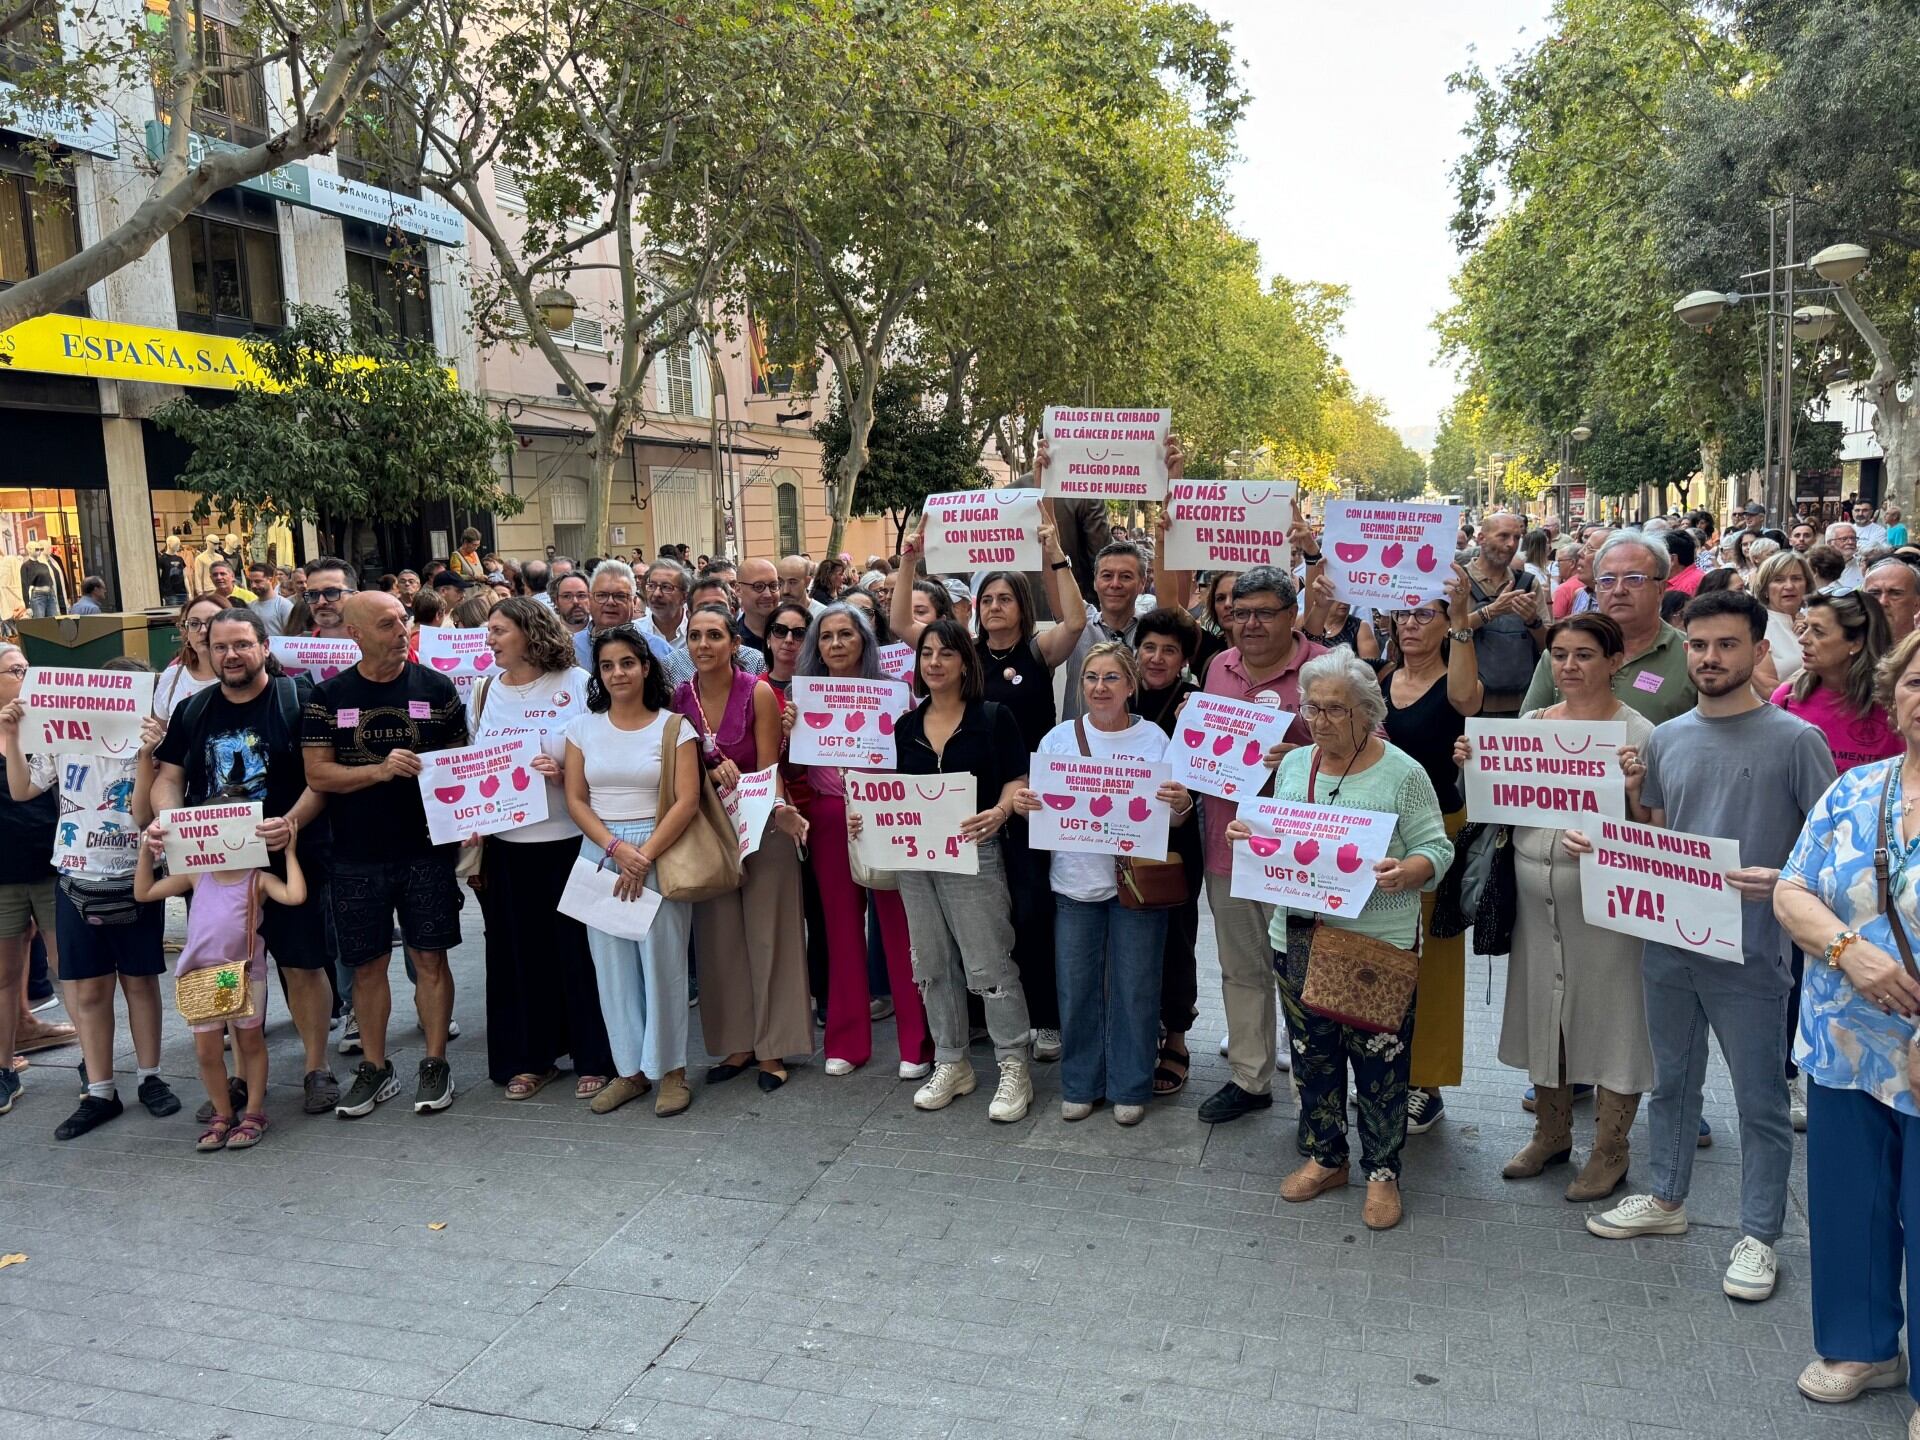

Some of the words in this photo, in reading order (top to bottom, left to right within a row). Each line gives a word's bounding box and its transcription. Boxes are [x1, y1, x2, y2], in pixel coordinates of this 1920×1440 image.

[431, 212, 440, 222] DE
[443, 217, 459, 227] VIDA
[1055, 411, 1088, 422] FALLOS
[1091, 412, 1102, 422] EN
[1104, 412, 1114, 422] EL
[1117, 412, 1160, 422] CRIBADO
[1055, 428, 1071, 438] DEL
[1073, 427, 1108, 439] CÁNCER
[1111, 429, 1123, 439] DE
[1125, 430, 1155, 440] MAMA
[1069, 464, 1110, 475] PELIGRO
[1112, 465, 1140, 476] PARA
[1061, 481, 1088, 492] MILES
[1090, 482, 1102, 493] DE
[1104, 483, 1147, 494] MUJERES
[1174, 485, 1193, 499] NO
[1196, 483, 1227, 500] MÁS
[928, 495, 966, 506] BASTA
[970, 494, 985, 503] YA
[943, 510, 957, 522] DE
[960, 508, 998, 522] JUGAR
[1176, 505, 1246, 522] RECORTES
[1346, 509, 1361, 518] CON
[1363, 510, 1372, 519] LA
[1374, 510, 1396, 520] MANO
[1398, 512, 1407, 521] EN
[1409, 512, 1416, 521] EL
[1418, 513, 1442, 523] PECHO
[945, 530, 967, 543] CON
[971, 528, 1024, 542] NUESTRA
[1196, 528, 1213, 542] EN
[1217, 529, 1283, 546] SANIDAD
[1360, 523, 1394, 533] DECIMOS
[1395, 525, 1425, 536] ¡BASTA!
[968, 548, 1015, 563] SALUD
[1210, 546, 1270, 564] PUBLICA
[1349, 571, 1376, 584] UGT
[38, 672, 51, 685] NI
[55, 672, 84, 686] UNA
[88, 674, 132, 689] MUJER
[826, 684, 834, 692] LA
[835, 684, 855, 692] MANO
[857, 685, 865, 693] EN
[866, 686, 873, 694] EL
[873, 687, 892, 696] PECHO
[31, 694, 136, 712] DESINFORMADA
[824, 696, 855, 704] DECIMOS
[856, 696, 881, 705] ¡BASTA!
[525, 710, 546, 718] UGT
[1197, 700, 1209, 710] CON
[1209, 702, 1217, 711] LA
[1218, 703, 1235, 715] MANO
[1235, 707, 1244, 717] EN
[1244, 709, 1252, 718] EL
[1252, 711, 1275, 723] PECHO
[1203, 713, 1230, 726] DECIMOS
[1230, 718, 1256, 732] ¡BASTA!
[43, 720, 92, 743] ¡YA!
[362, 728, 412, 739] GUESS
[819, 736, 843, 746] UGT
[1479, 736, 1498, 750] LA
[1502, 737, 1543, 752] VIDA
[436, 757, 451, 766] CON
[452, 756, 460, 764] LA
[462, 751, 484, 762] MANO
[485, 749, 494, 757] EN
[494, 746, 502, 755] EL
[502, 740, 523, 753] PECHO
[452, 762, 485, 775] DECIMOS
[487, 754, 512, 768] ¡BASTA!
[1050, 762, 1067, 772] CON
[1068, 763, 1078, 772] LA
[1079, 764, 1101, 774] MANO
[1104, 766, 1114, 775] EN
[1115, 767, 1124, 776] EL
[1125, 768, 1152, 778] PECHO
[1191, 756, 1208, 771] UGT
[1481, 756, 1500, 771] DE
[1504, 756, 1533, 772] LAS
[1536, 758, 1605, 777] MUJERES
[64, 764, 90, 792] 91
[1065, 776, 1101, 786] DECIMOS
[1103, 778, 1134, 789] ¡BASTA!
[744, 787, 768, 797] MAMA
[851, 781, 905, 801] 2.000
[1493, 784, 1599, 813] IMPORTA
[171, 811, 192, 823] NOS
[194, 806, 252, 821] QUEREMOS
[454, 805, 481, 820] UGT
[876, 813, 894, 826] NO
[896, 812, 921, 825] SON
[1259, 805, 1277, 814] CON
[1278, 806, 1289, 815] LA
[1290, 808, 1317, 819] MANO
[1318, 812, 1329, 821] EN
[1331, 814, 1340, 822] EL
[1342, 815, 1372, 826] PECHO
[1060, 817, 1088, 830] UGT
[1272, 818, 1312, 830] DECIMOS
[1313, 823, 1349, 835] ¡BASTA!
[179, 825, 219, 839] VIVAS
[197, 841, 205, 851] Y
[1603, 822, 1618, 840] NI
[1621, 825, 1655, 849] UNA
[1657, 833, 1712, 860] MUJER
[185, 853, 226, 866] SANAS
[927, 850, 935, 859] o
[1264, 865, 1294, 881] UGT
[1598, 848, 1722, 891] DESINFORMADA
[1607, 885, 1664, 922] ¡YA!
